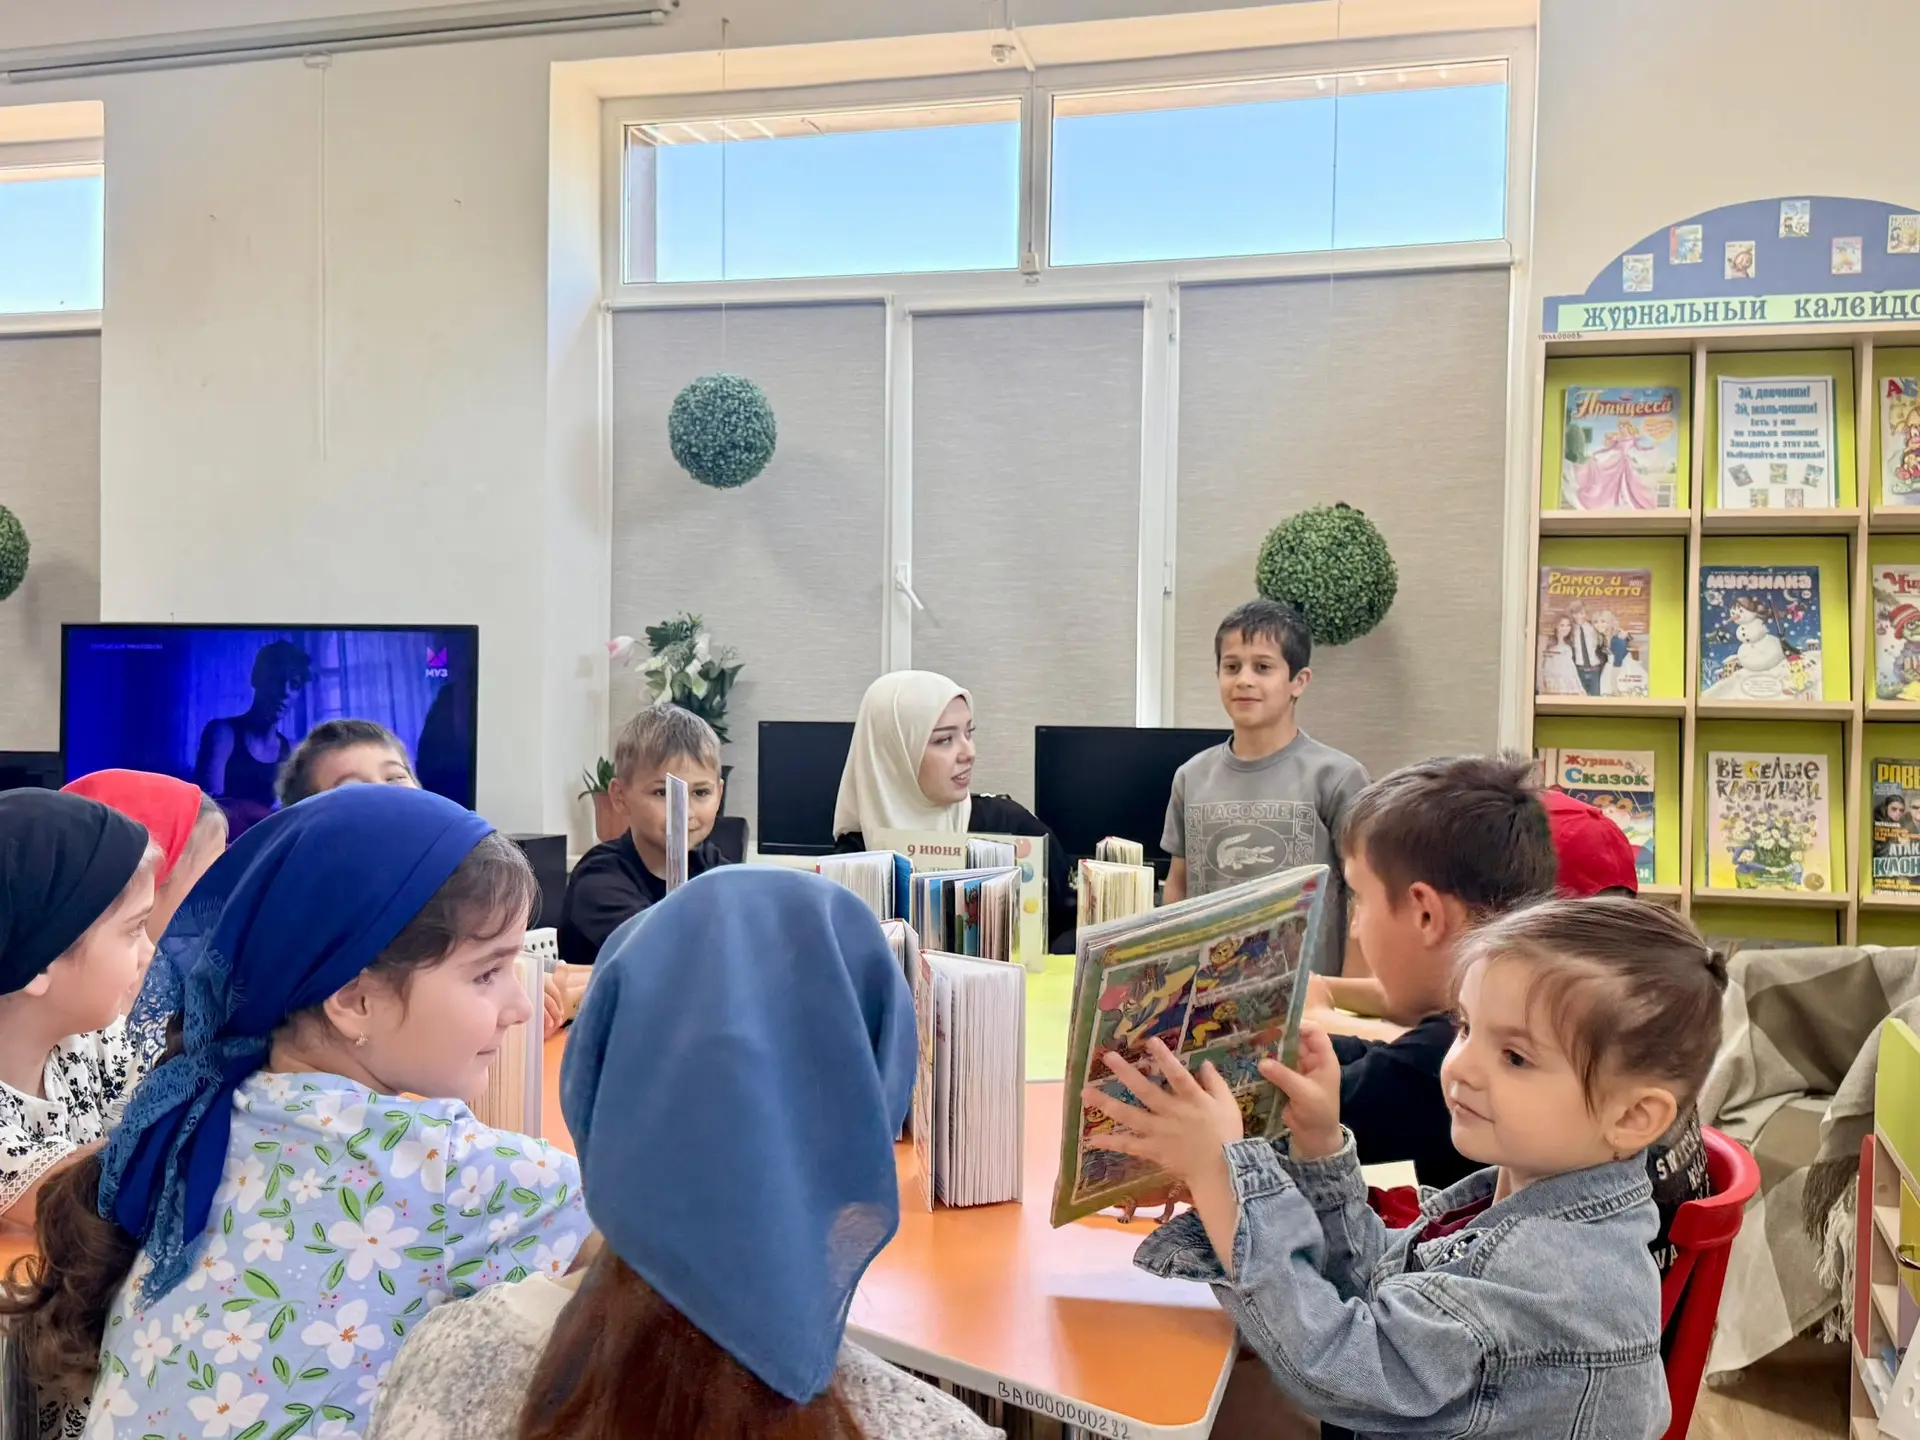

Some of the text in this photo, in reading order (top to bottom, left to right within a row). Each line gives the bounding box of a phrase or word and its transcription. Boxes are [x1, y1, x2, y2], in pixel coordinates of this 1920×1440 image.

[1583, 295, 1767, 331] журнальный
[1571, 389, 1674, 419] Принцесса
[1548, 572, 1604, 585] Ромео
[1706, 574, 1812, 590] МУРЗИЛКА
[1548, 583, 1642, 599] Джульетта
[1564, 754, 1624, 767] Журнал
[1564, 767, 1650, 786] Сказок
[1204, 803, 1292, 821] LACOSTE
[907, 844, 962, 857] 9 июня
